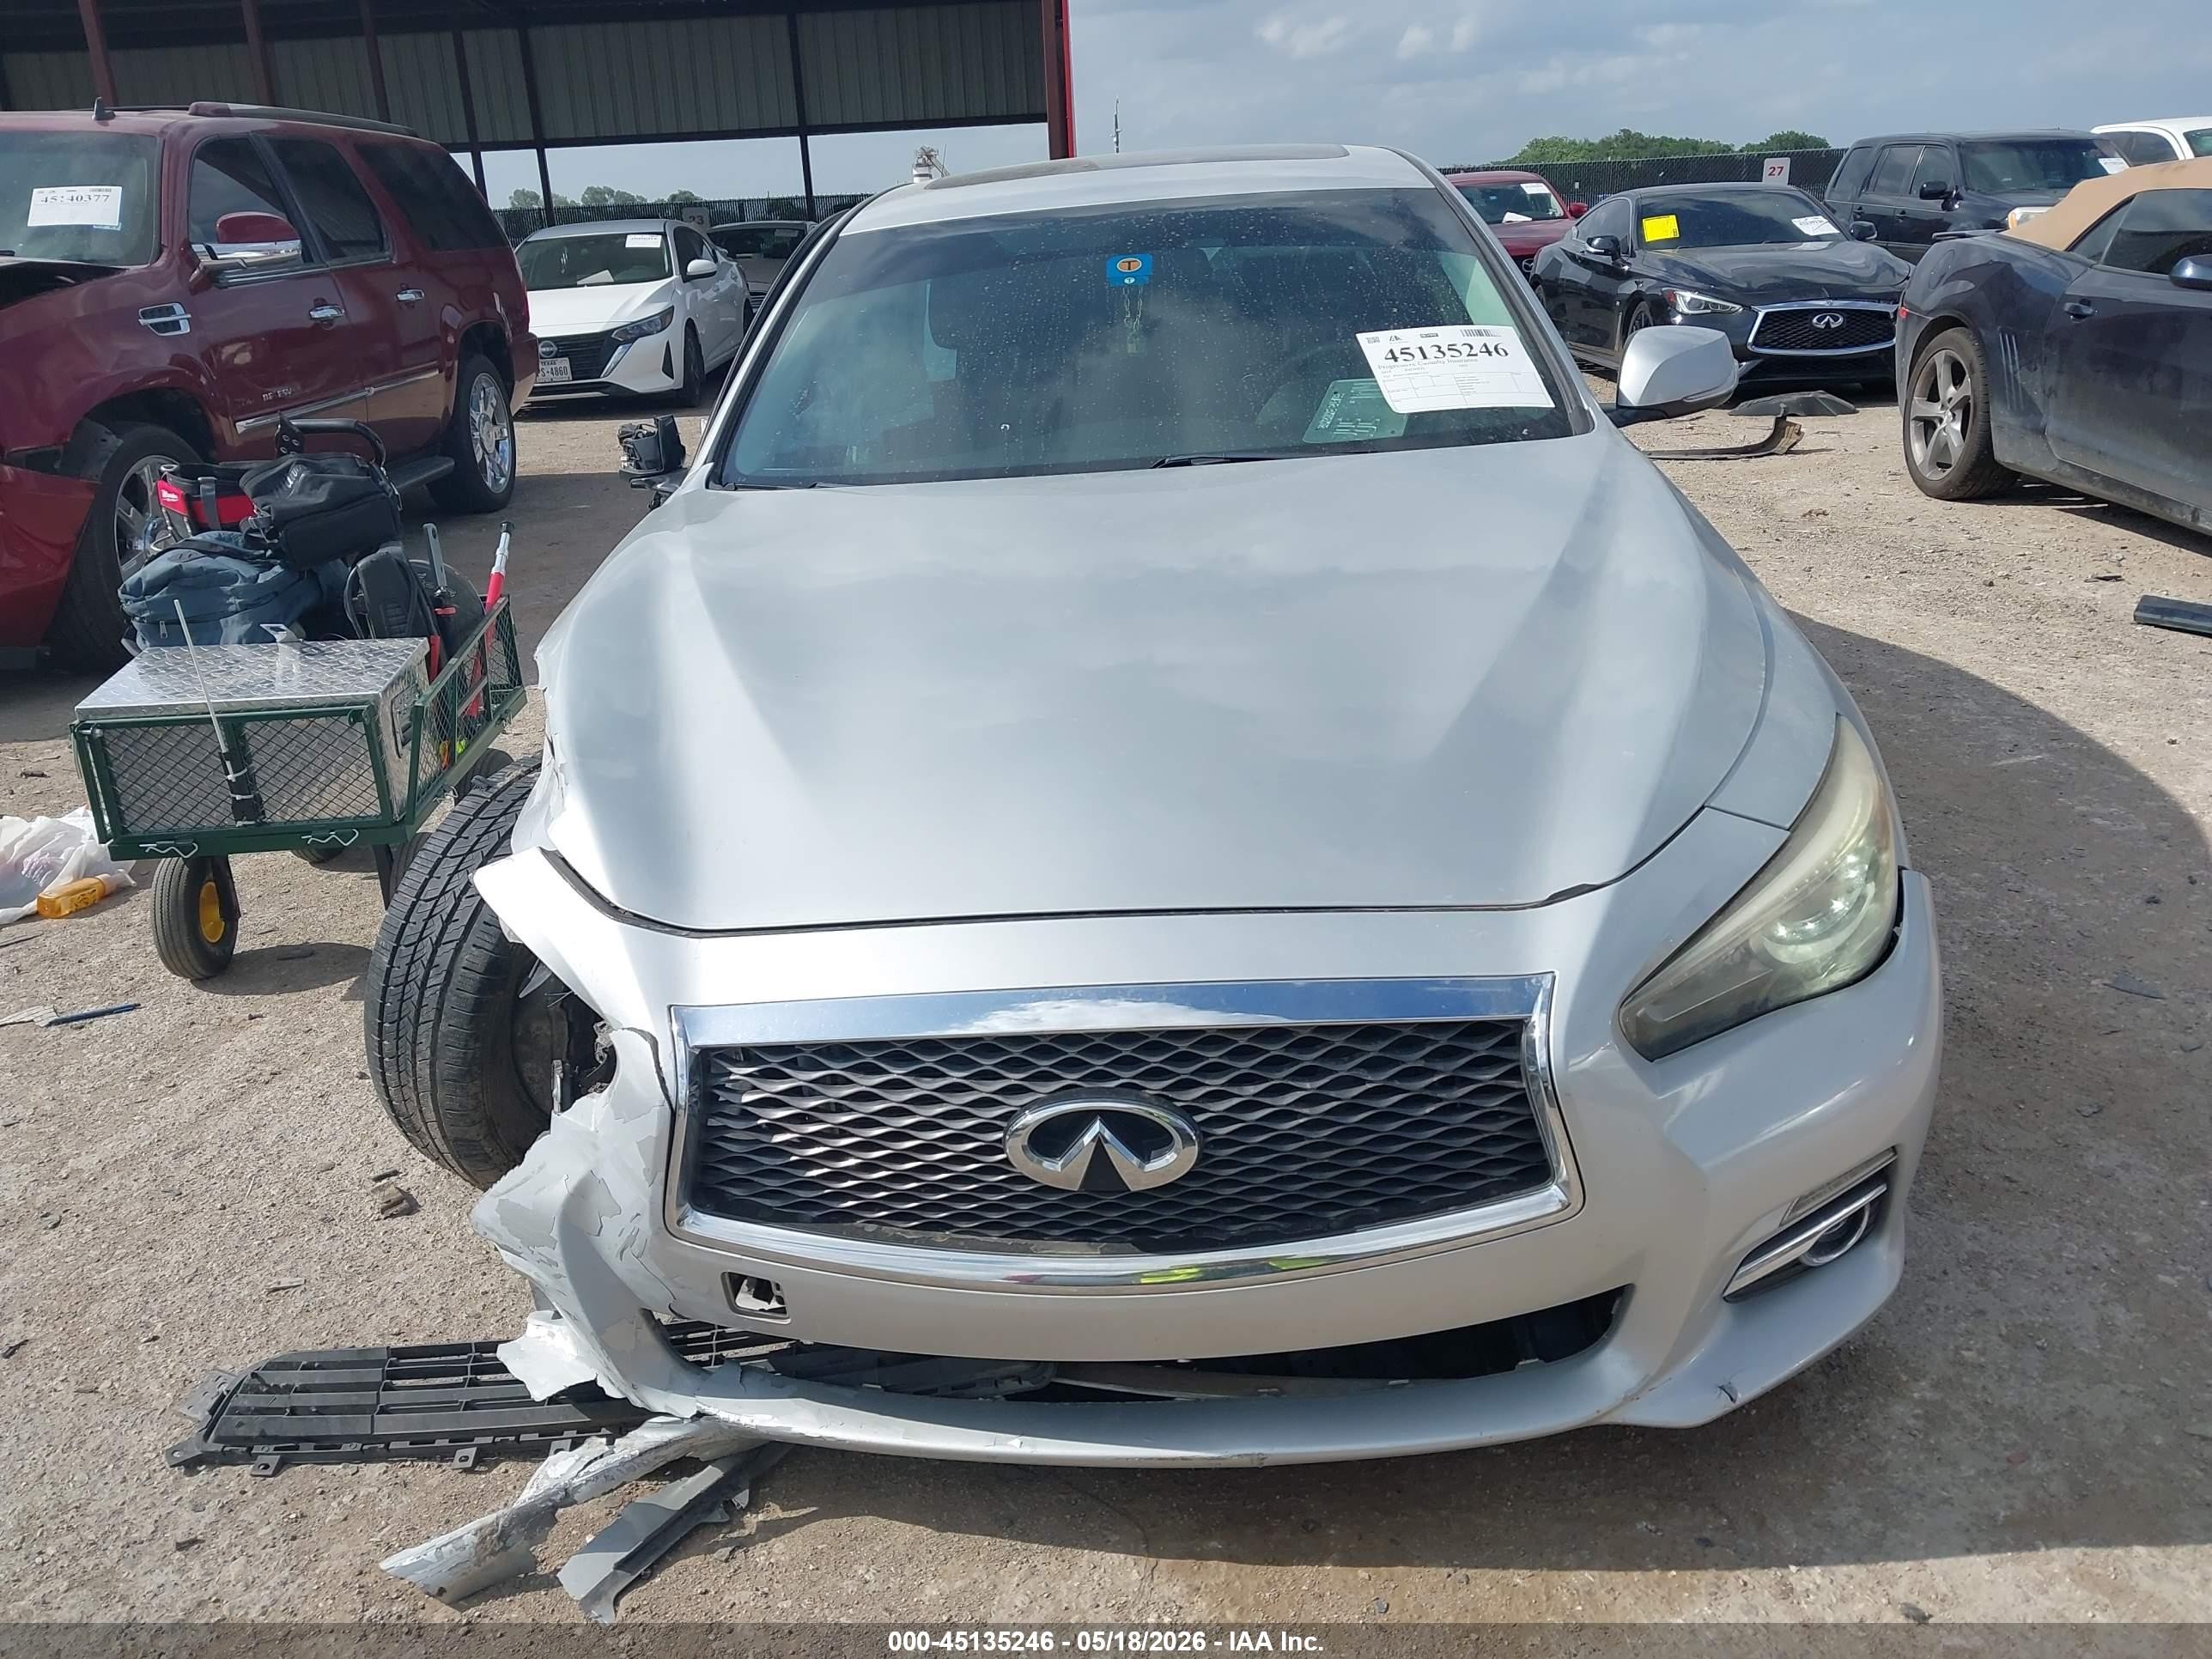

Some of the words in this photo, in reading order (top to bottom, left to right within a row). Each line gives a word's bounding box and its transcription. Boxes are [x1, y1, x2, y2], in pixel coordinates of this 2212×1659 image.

[1767, 166, 1784, 177] 27
[1121, 260, 1139, 270] T
[1384, 342, 1509, 362] 45135246
